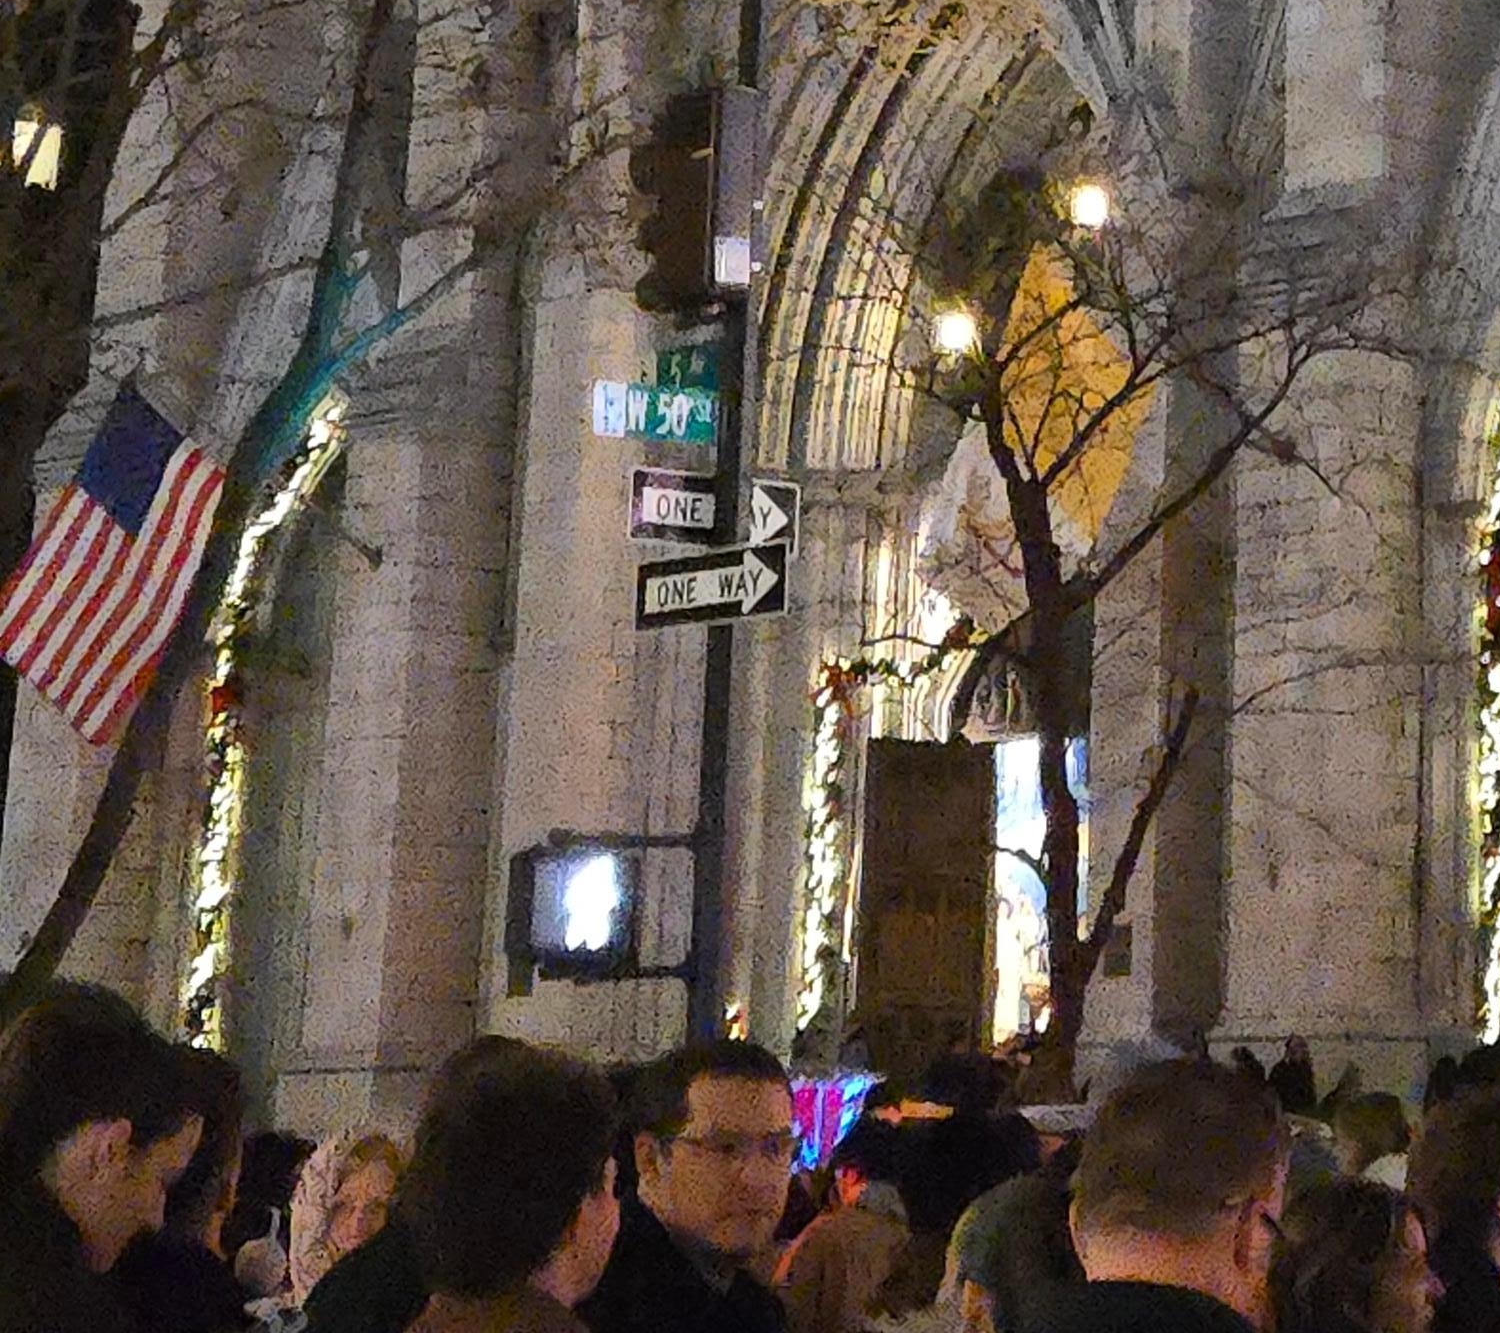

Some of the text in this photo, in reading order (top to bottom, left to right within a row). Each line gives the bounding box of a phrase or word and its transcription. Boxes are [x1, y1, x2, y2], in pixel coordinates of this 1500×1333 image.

[628, 388, 649, 432] W
[656, 392, 691, 437] 50
[656, 493, 703, 523] ONE
[657, 567, 764, 608] ONE WAY
